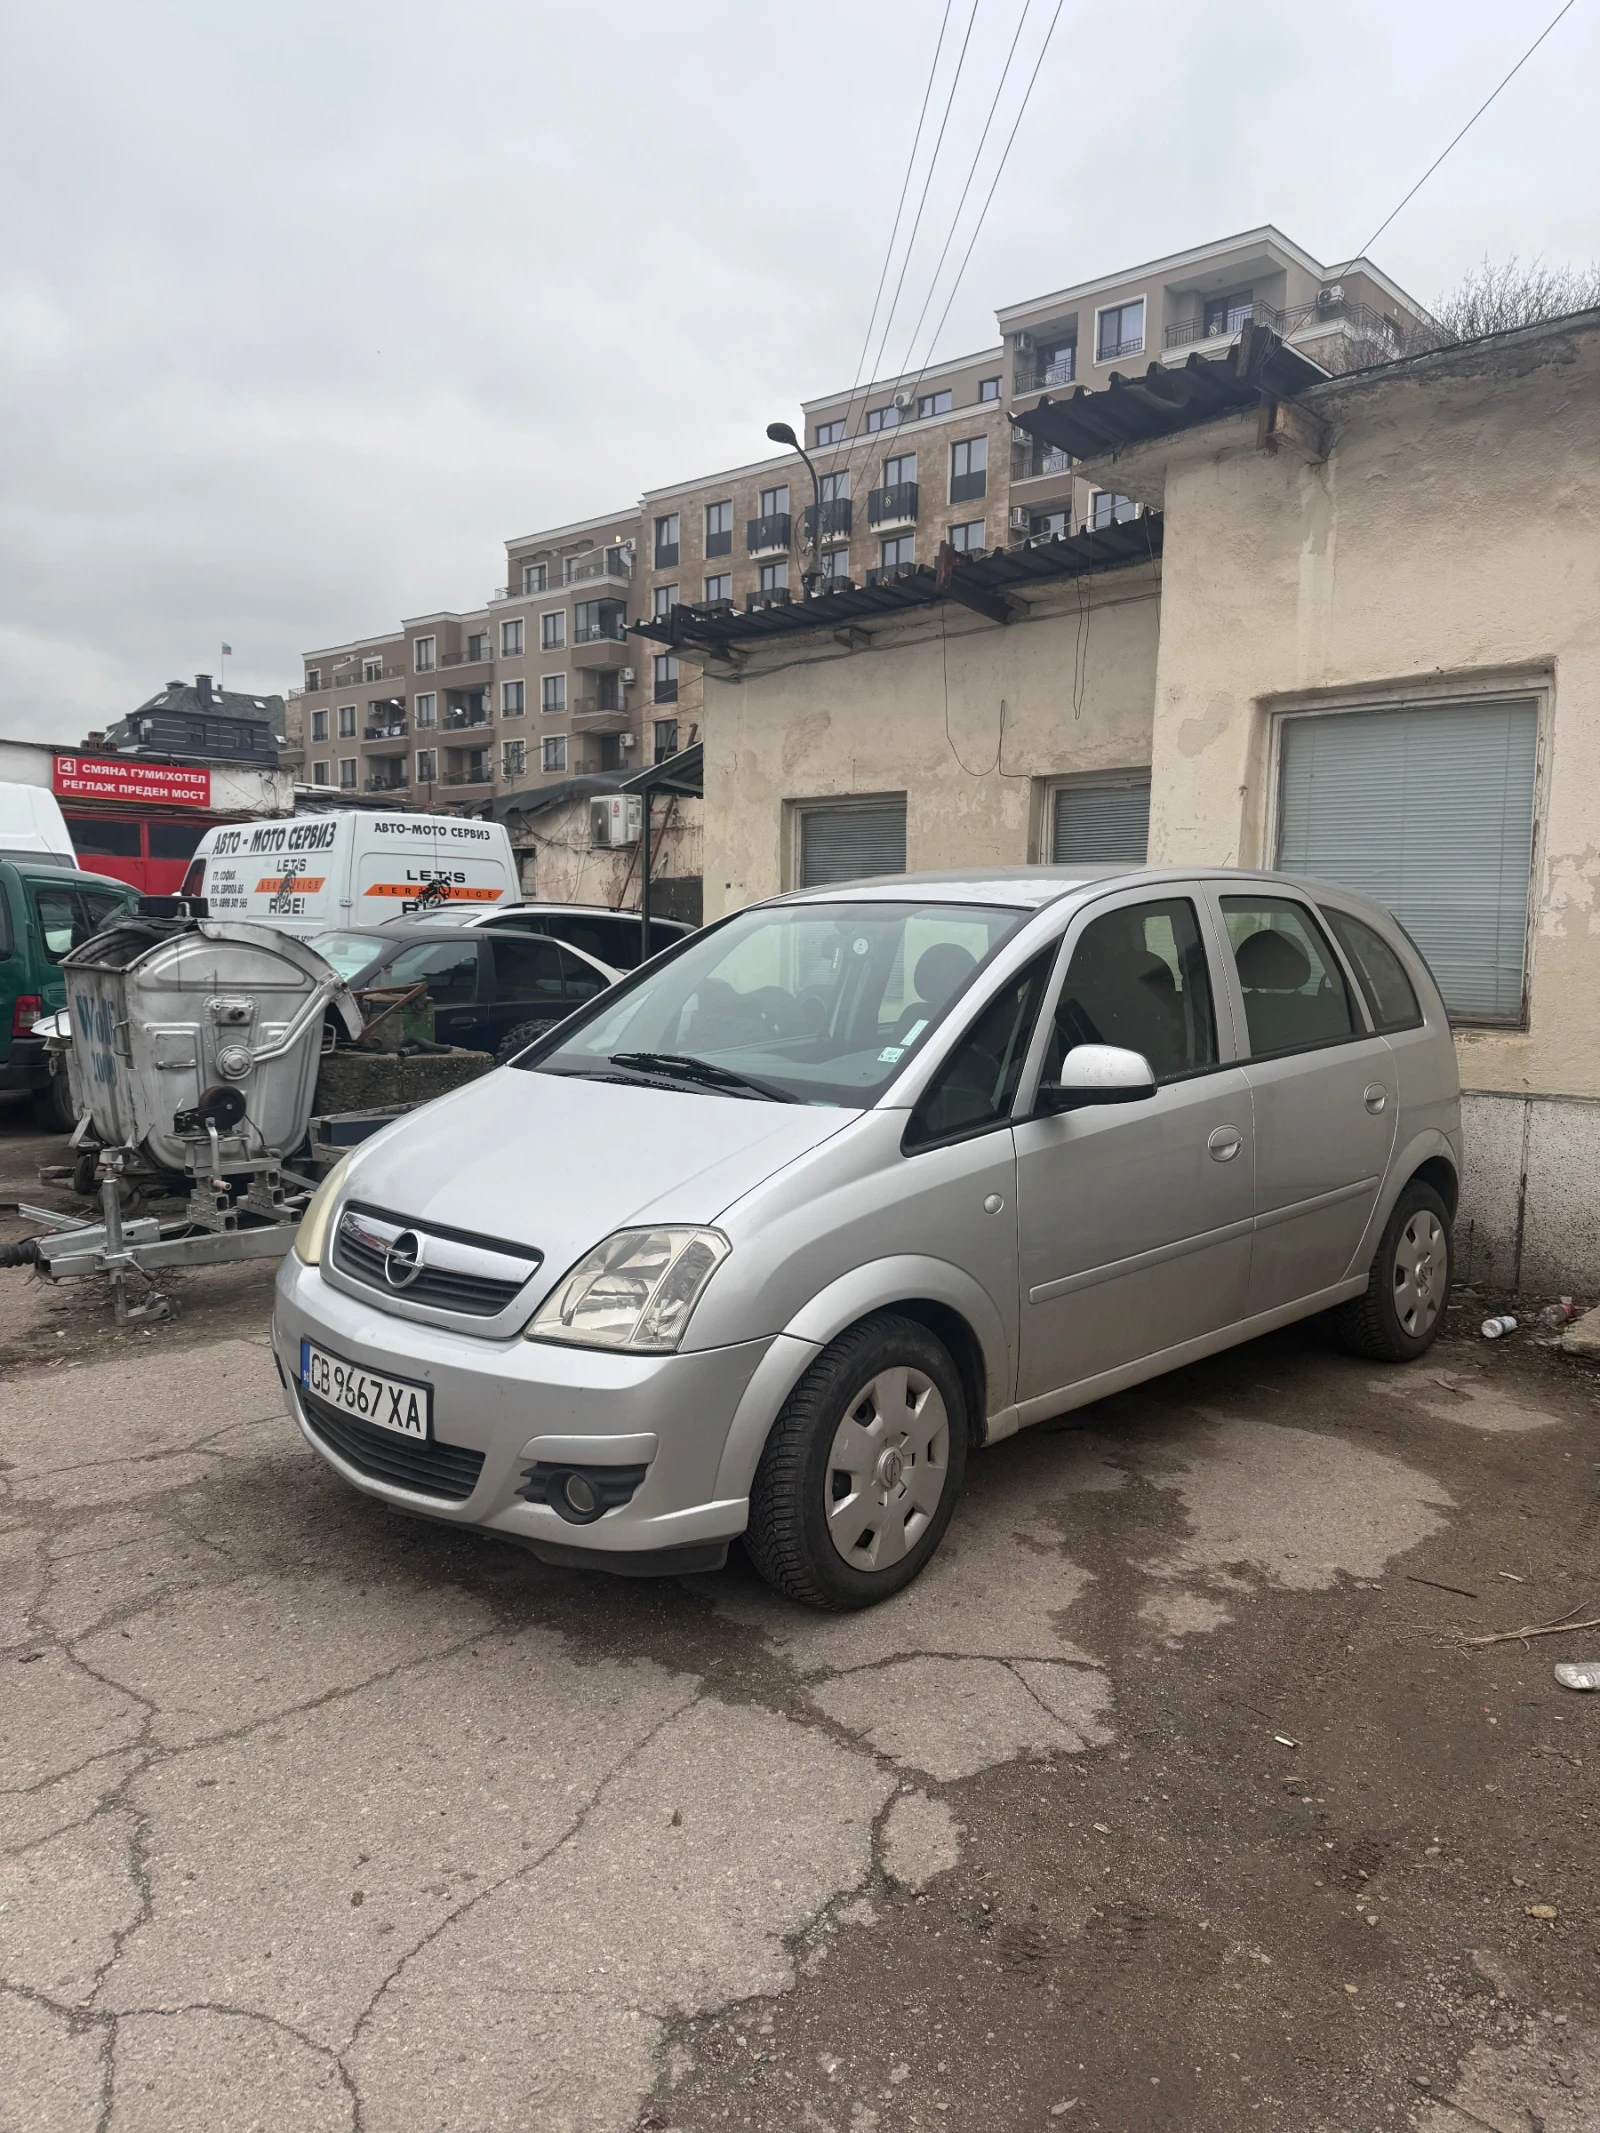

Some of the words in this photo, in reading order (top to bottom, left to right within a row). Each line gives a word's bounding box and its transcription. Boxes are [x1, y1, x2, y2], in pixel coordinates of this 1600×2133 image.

[82, 764, 127, 777] СМЯНА
[130, 768, 206, 784] ГУМИ/ХОТЕЛ
[62, 779, 116, 792] РЕГЛАЖ
[118, 784, 168, 797] ПРЕДЕН
[171, 790, 206, 800] МОСТ
[212, 831, 241, 855] АВТО
[249, 827, 286, 852] МОТО
[288, 821, 337, 850] СЕРВИЗ
[374, 822, 447, 836] АВТО-МОТО
[451, 827, 491, 840] СЕРВИЗ
[406, 869, 466, 883] LET'S
